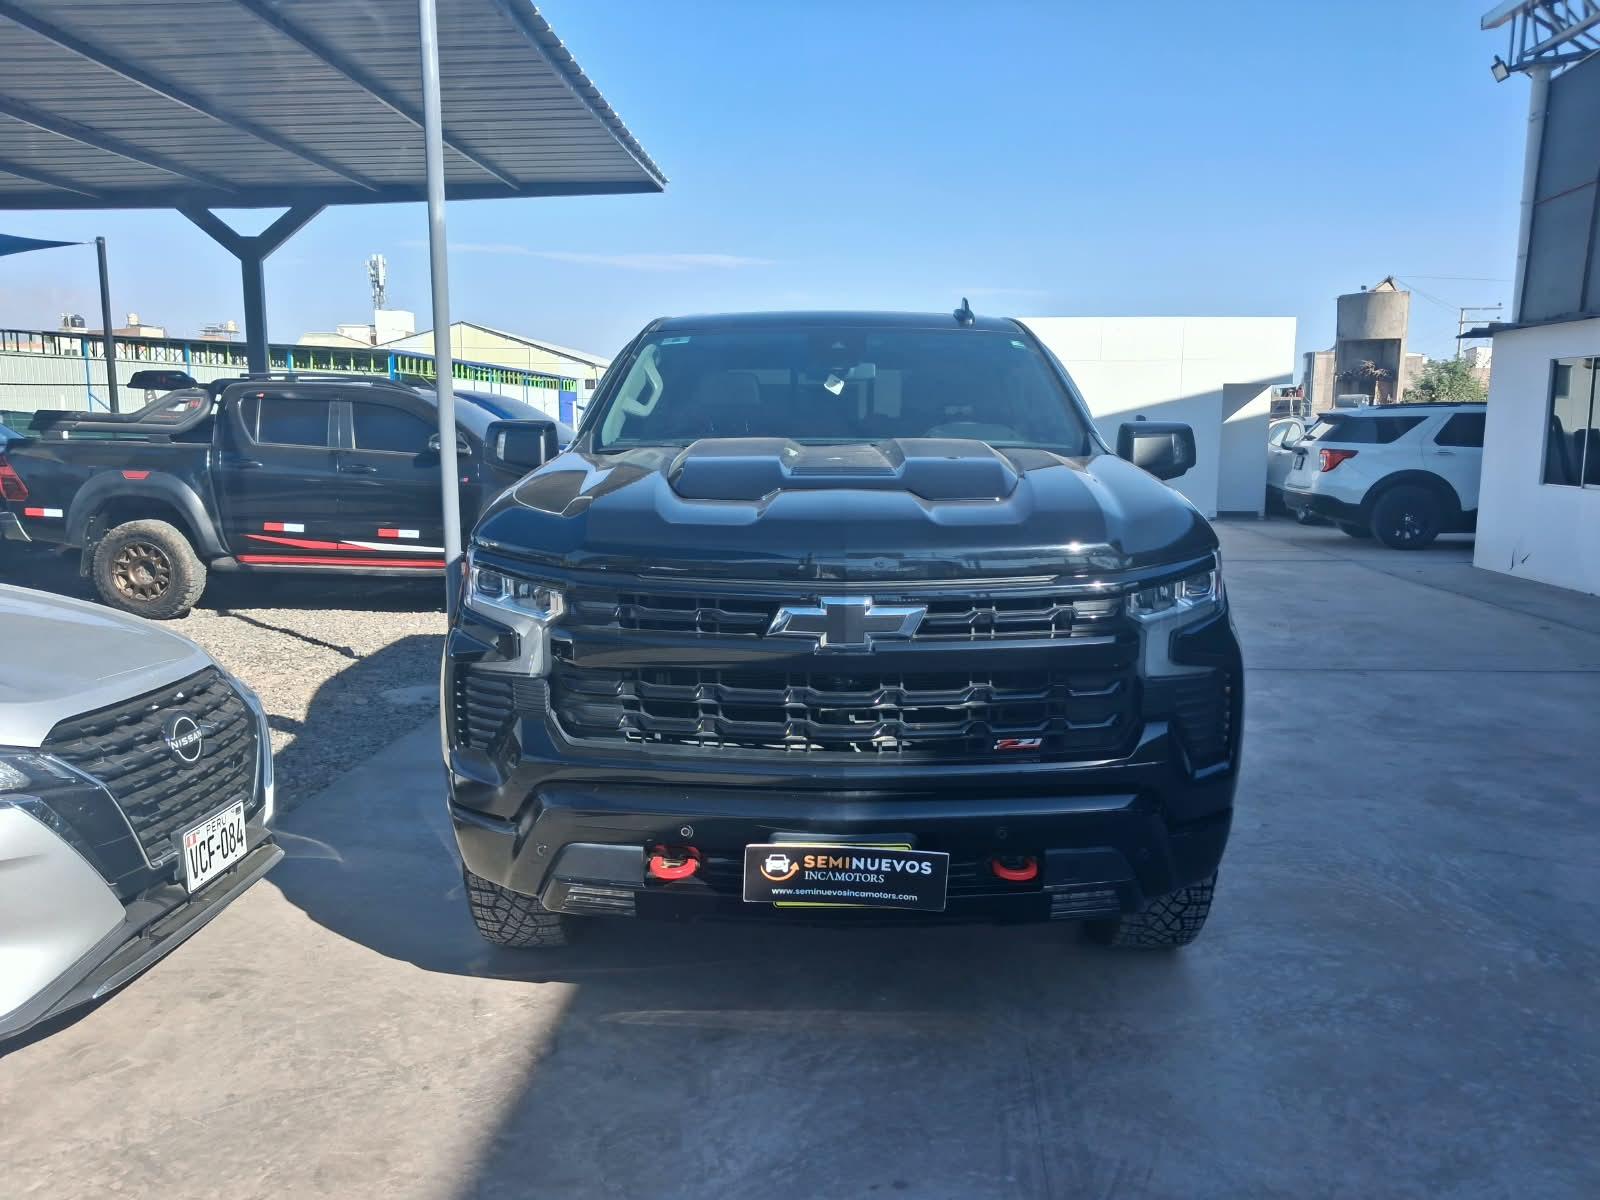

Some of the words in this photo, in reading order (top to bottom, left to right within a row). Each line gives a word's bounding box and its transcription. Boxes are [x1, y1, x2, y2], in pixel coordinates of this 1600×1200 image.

[170, 729, 202, 750] NISSAN
[189, 818, 244, 879] VCF-084
[803, 854, 932, 875] SEMINUEVOS
[804, 870, 885, 883] INCAMOTORS
[771, 887, 918, 902] www.seminuevosincamotors.com
